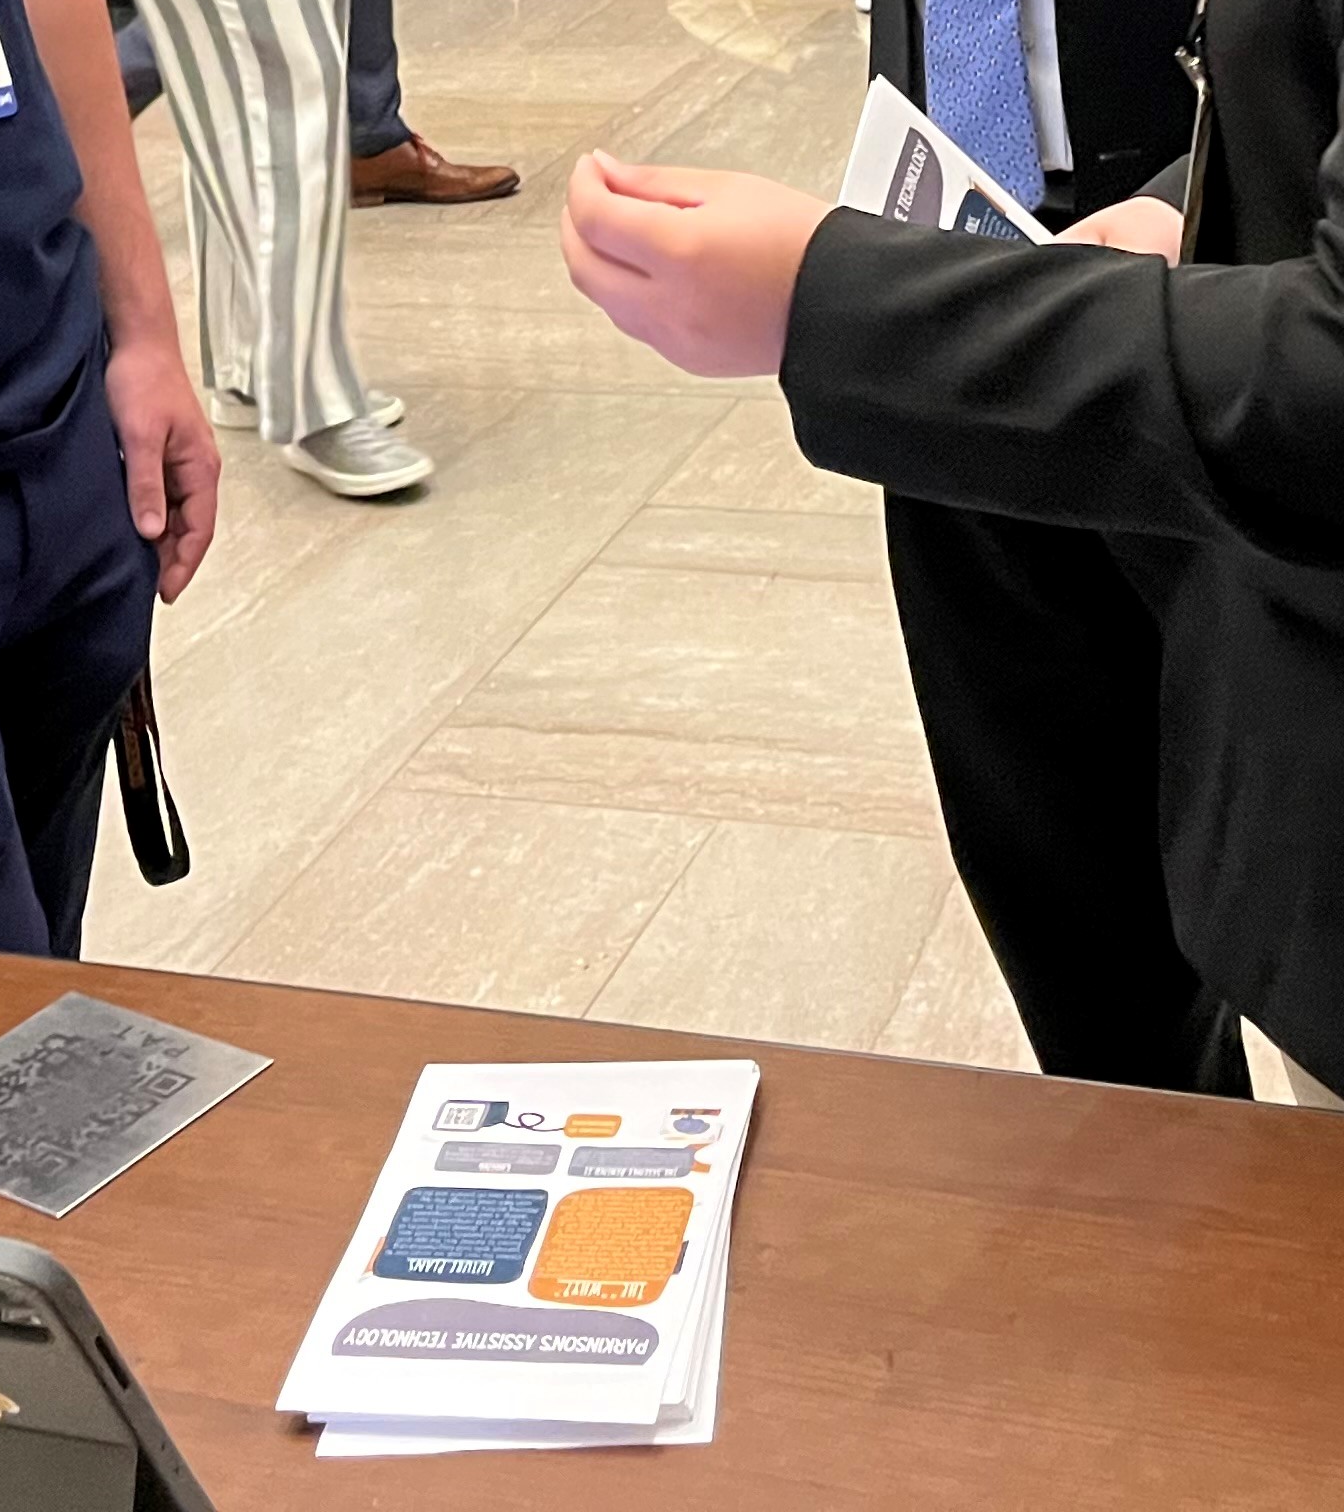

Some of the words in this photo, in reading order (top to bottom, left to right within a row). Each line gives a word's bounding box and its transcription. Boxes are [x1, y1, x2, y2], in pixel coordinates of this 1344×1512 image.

[407, 1257, 448, 1275] PLANS
[343, 1327, 449, 1348] TECHNOLOGY
[451, 1331, 537, 1351] ASSISTIVE
